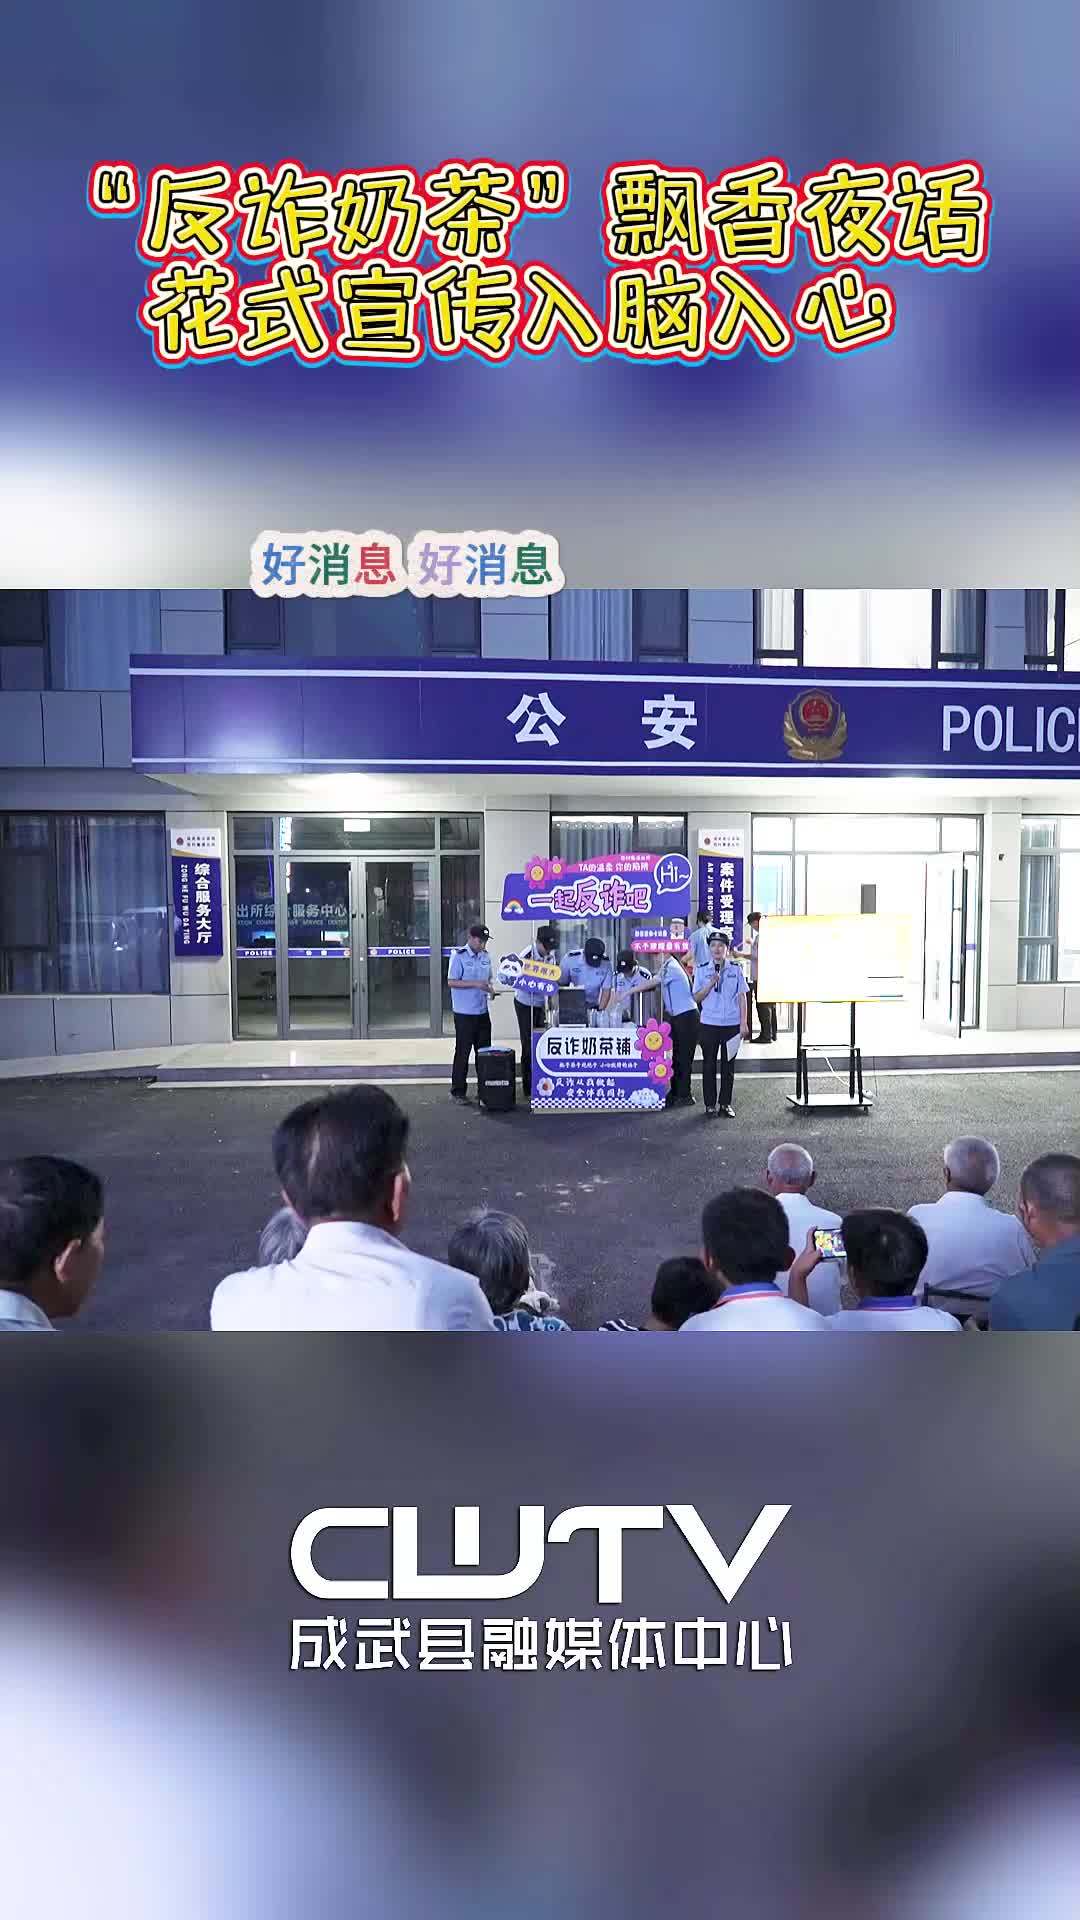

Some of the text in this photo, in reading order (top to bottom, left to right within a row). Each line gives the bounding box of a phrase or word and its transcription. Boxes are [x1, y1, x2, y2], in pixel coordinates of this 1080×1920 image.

[506, 691, 698, 751] 公安
[943, 704, 1080, 754] POLIC
[182, 895, 189, 904] FU
[194, 863, 212, 944] 综合服务大厅
[530, 878, 649, 914] 一起反诈吧
[547, 1037, 631, 1056] 反诈奶茶铺
